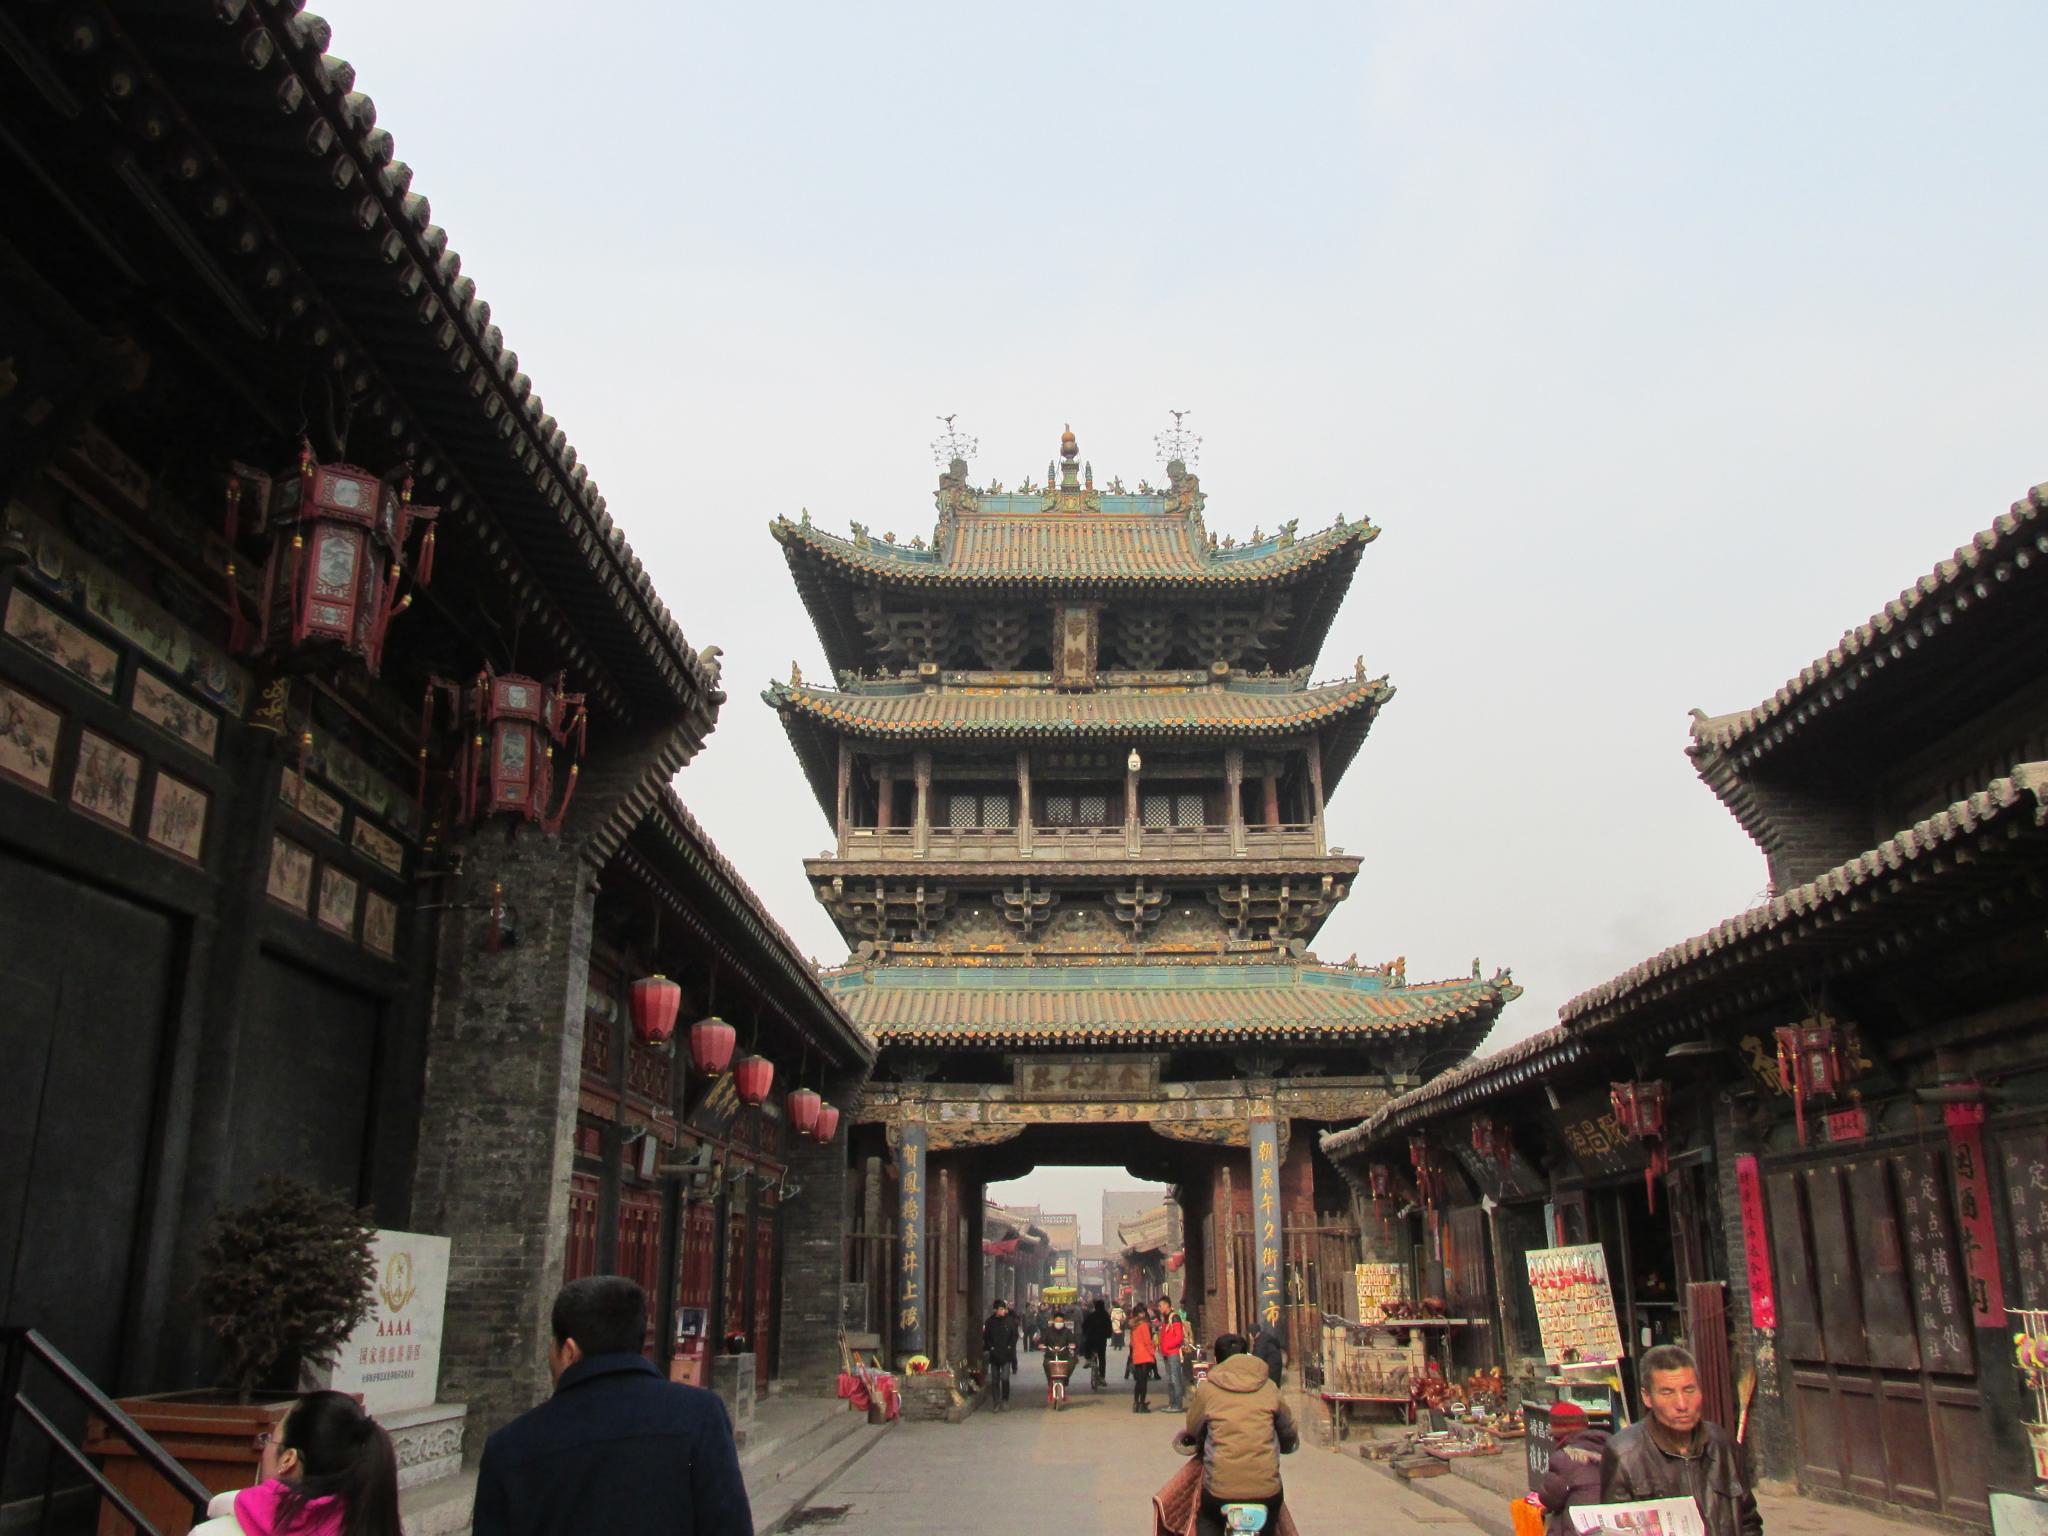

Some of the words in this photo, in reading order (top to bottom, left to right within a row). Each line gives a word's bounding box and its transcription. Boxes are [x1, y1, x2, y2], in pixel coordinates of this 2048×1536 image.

[1902, 1167, 1942, 1359] 中国旅游出版社
[1920, 1175, 1960, 1352] 定点销售处
[359, 1344, 421, 1365] 国家级旅游景区
[376, 1319, 411, 1337] AAAA
